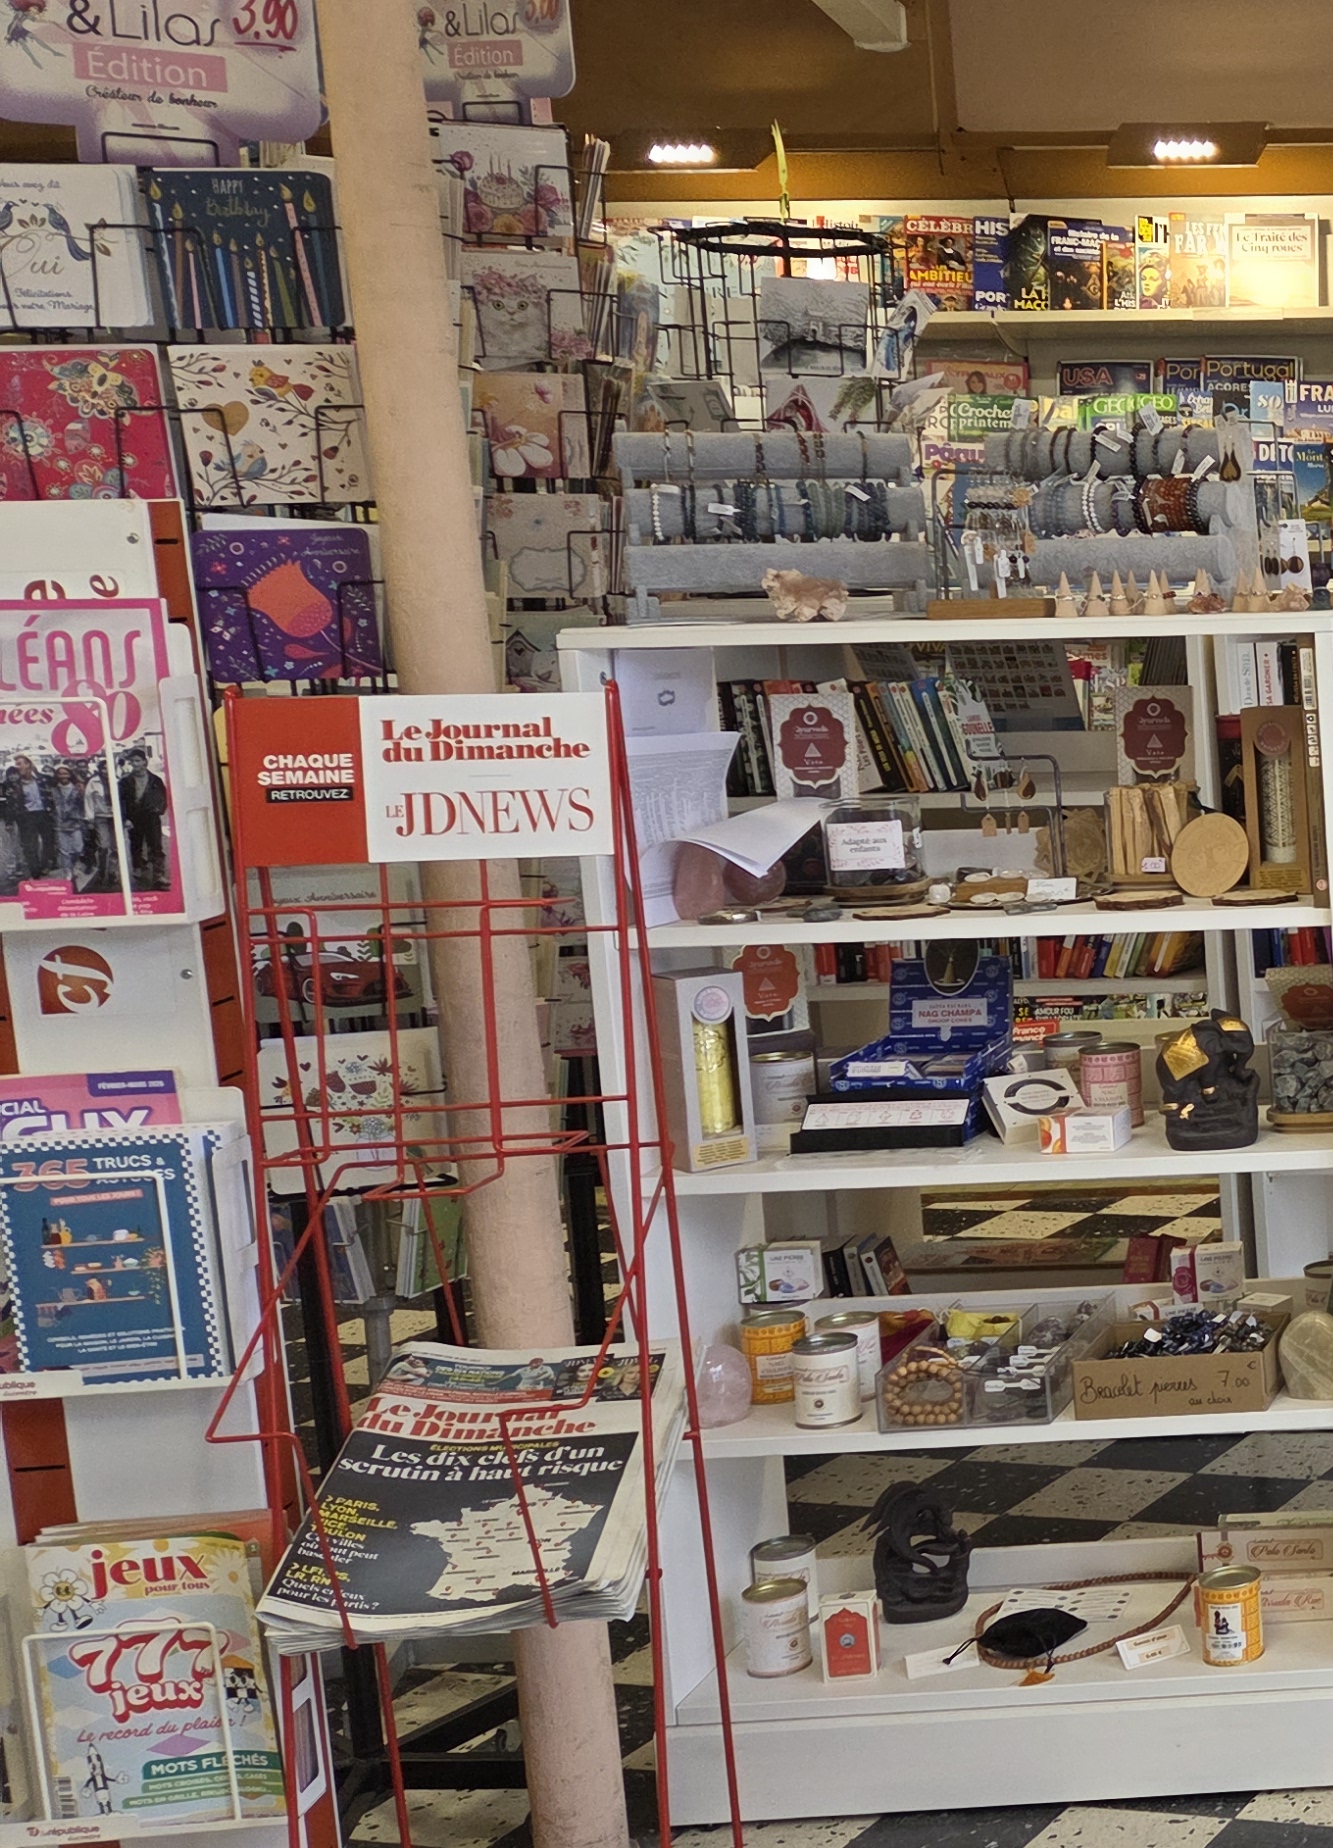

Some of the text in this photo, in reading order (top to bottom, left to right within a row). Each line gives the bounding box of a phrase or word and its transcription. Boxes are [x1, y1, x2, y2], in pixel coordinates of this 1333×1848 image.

[111, 0, 220, 46] Lilas
[463, 2, 519, 35] Lilas
[454, 44, 514, 66] Édition
[88, 47, 208, 87] Édition
[211, 178, 244, 194] HAPPY
[974, 220, 1008, 236] HIS
[1236, 231, 1308, 243] Le Traité des
[1274, 245, 1303, 254] roues
[909, 270, 974, 282] AMBITIEU
[1062, 366, 1113, 387] USA
[1206, 361, 1294, 384] Portugal
[380, 716, 553, 741] Le Journal
[381, 737, 592, 763] du Dimanche
[263, 753, 354, 770] CHAQUE
[257, 769, 355, 786] SEMAINE
[270, 788, 349, 801] RETROUVEZ
[385, 786, 595, 837] LE JDNEWS
[848, 843, 882, 853] enfants
[918, 1008, 983, 1018] NAG CHAMPA
[12, 1155, 166, 1192] 365 TRUCS &
[1079, 1373, 1198, 1405] Bracelet pierres
[366, 1396, 412, 1418] Le
[356, 1413, 408, 1434] du
[370, 1443, 605, 1467] Les dix clefs d'un
[339, 1457, 442, 1482] scrutin
[448, 1463, 465, 1482] à
[539, 1458, 625, 1477] risque
[91, 1549, 209, 1600] jeux
[144, 1580, 211, 1597] pour tous
[107, 1678, 206, 1724] jeux
[76, 1720, 178, 1743] Le record du
[151, 1760, 198, 1776] MOTS
